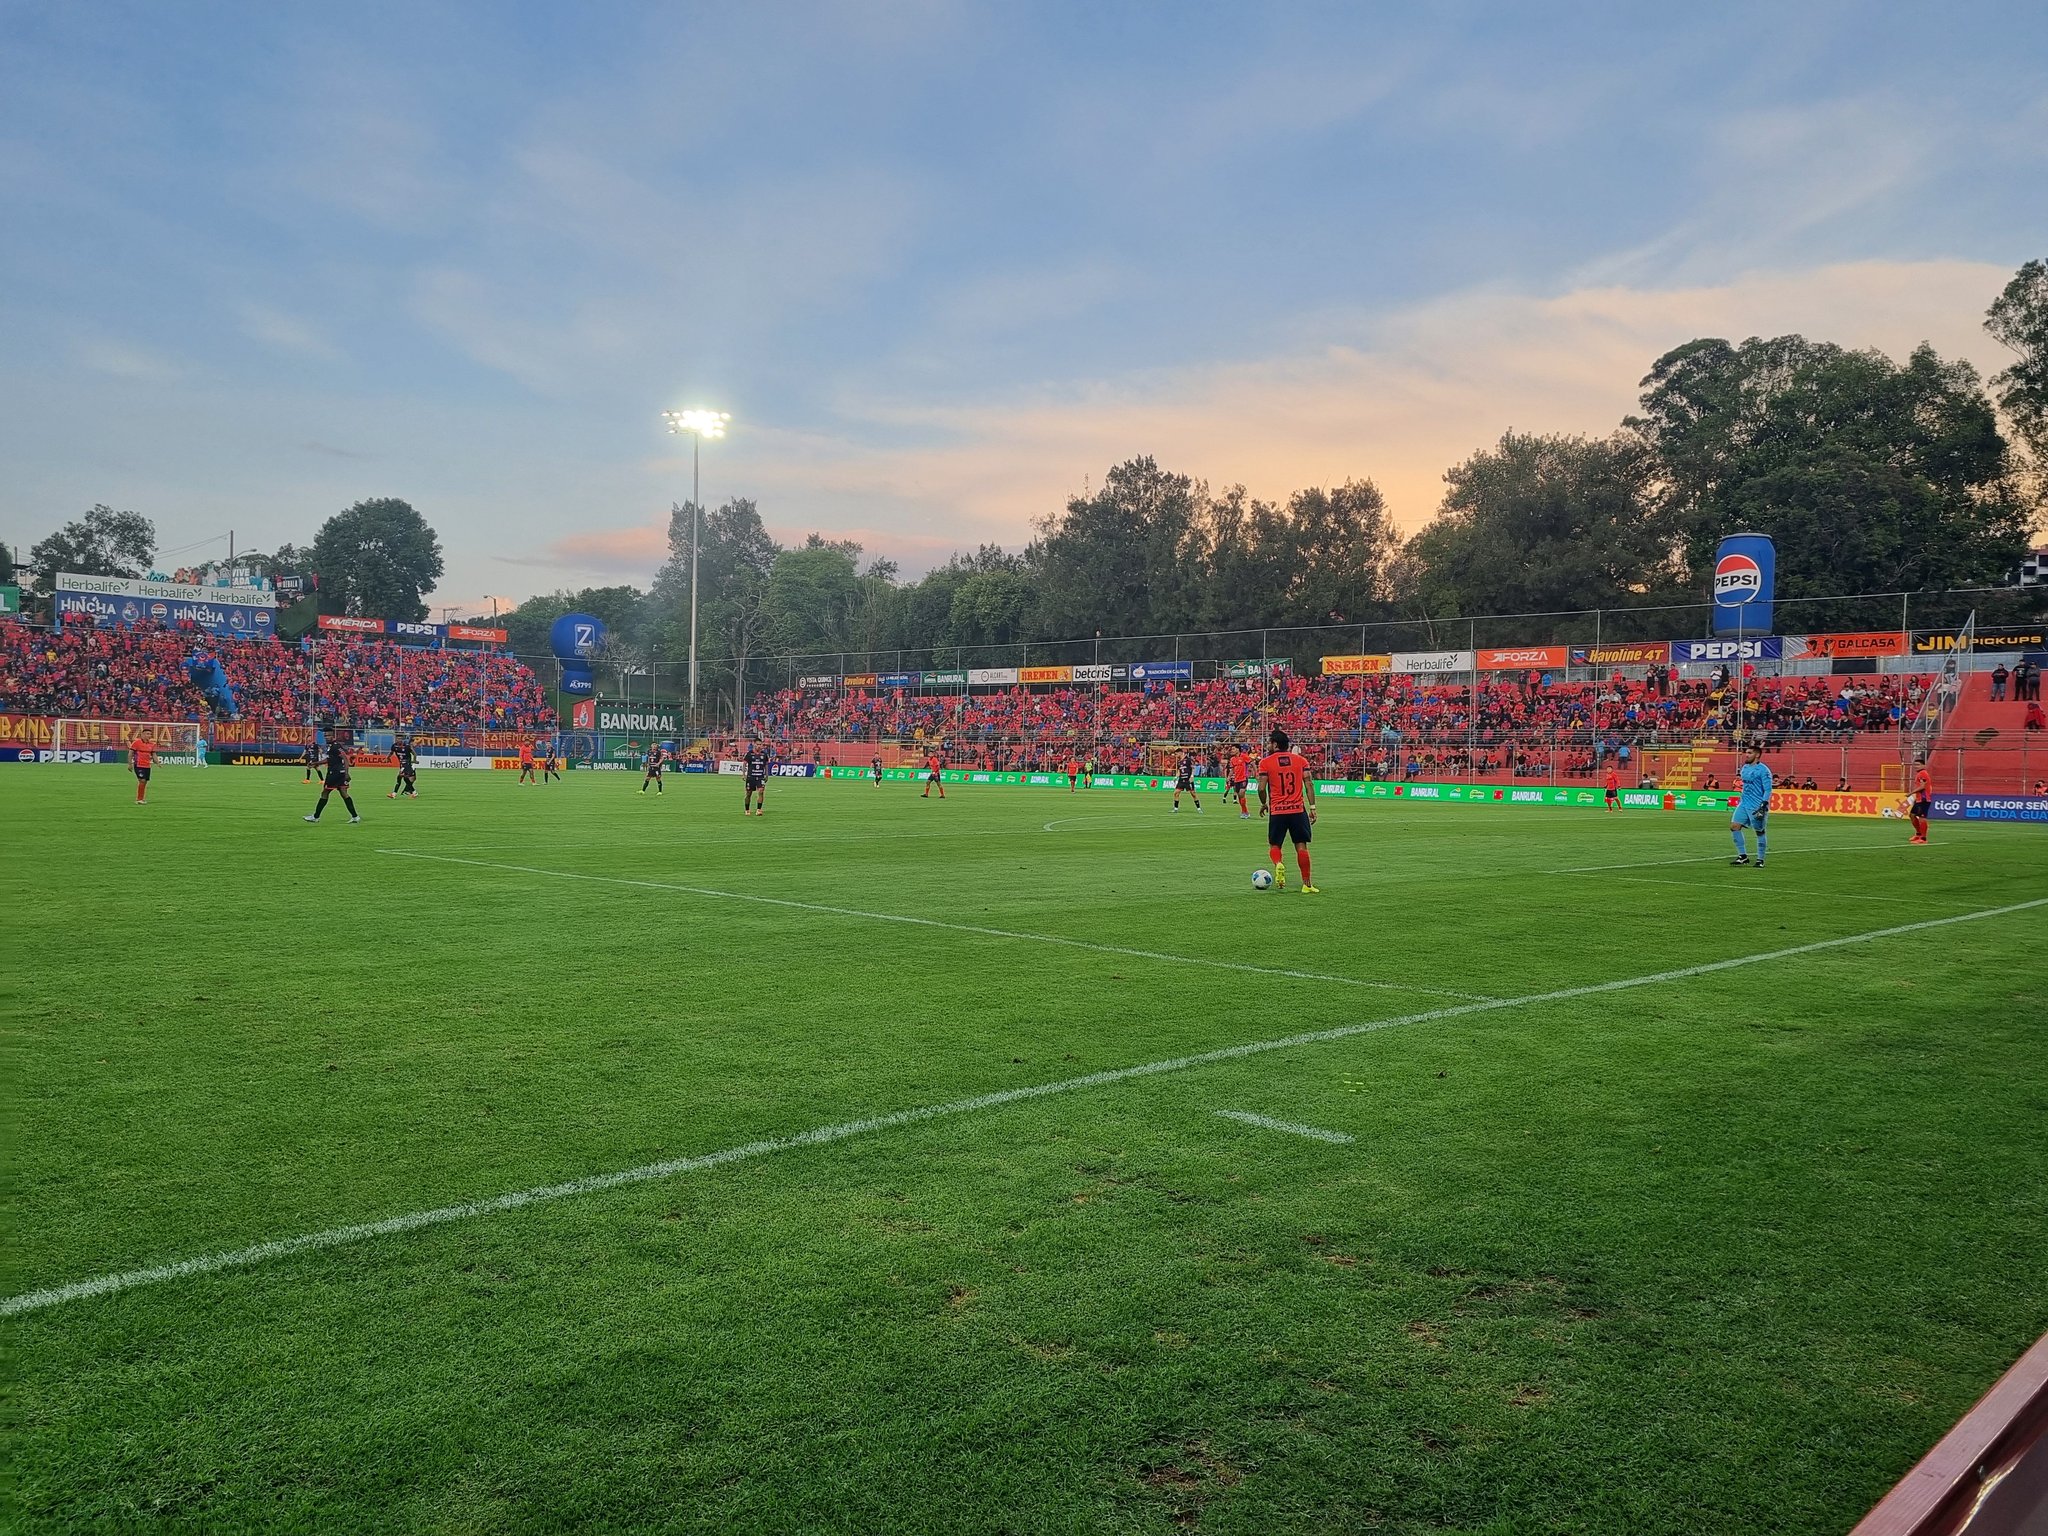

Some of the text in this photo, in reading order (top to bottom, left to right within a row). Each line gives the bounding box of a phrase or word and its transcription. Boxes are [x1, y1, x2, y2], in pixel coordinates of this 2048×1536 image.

[61, 577, 121, 593] Herbalife
[1716, 575, 1758, 589] PEPSI
[138, 584, 195, 599] Herbalife
[210, 591, 263, 605] Herbalife
[60, 596, 117, 615] HINCHA
[173, 605, 225, 622] HINCHA
[396, 622, 438, 636] PEPSI
[577, 626, 592, 647] Z
[1838, 638, 1896, 649] GALCASA
[1917, 635, 2042, 651] JIM PICKUPS
[1504, 651, 1549, 662] FORZA
[1589, 649, 1664, 663] Havoline 4T
[1690, 641, 1762, 660] PEPSI
[1406, 656, 1454, 671] Herbalife
[1021, 670, 1058, 680] BREMEN
[600, 712, 677, 732] BANRURAL
[39, 750, 101, 764] PEPSI
[231, 755, 264, 765] JIM
[429, 759, 469, 769] Herbalife
[494, 759, 546, 770] BREEN
[593, 762, 628, 771] BANRURAL
[779, 764, 807, 777] PEPSI
[1277, 772, 1296, 797] 13
[1511, 790, 1544, 802] BANRURAL
[1624, 793, 1660, 806] BANRURAL
[1769, 793, 1879, 815] BREMEN
[1934, 799, 1961, 816] tigo
[1966, 799, 1982, 809] LA
[1983, 800, 2024, 810] MEJOR
[1982, 810, 2017, 819] TODA
